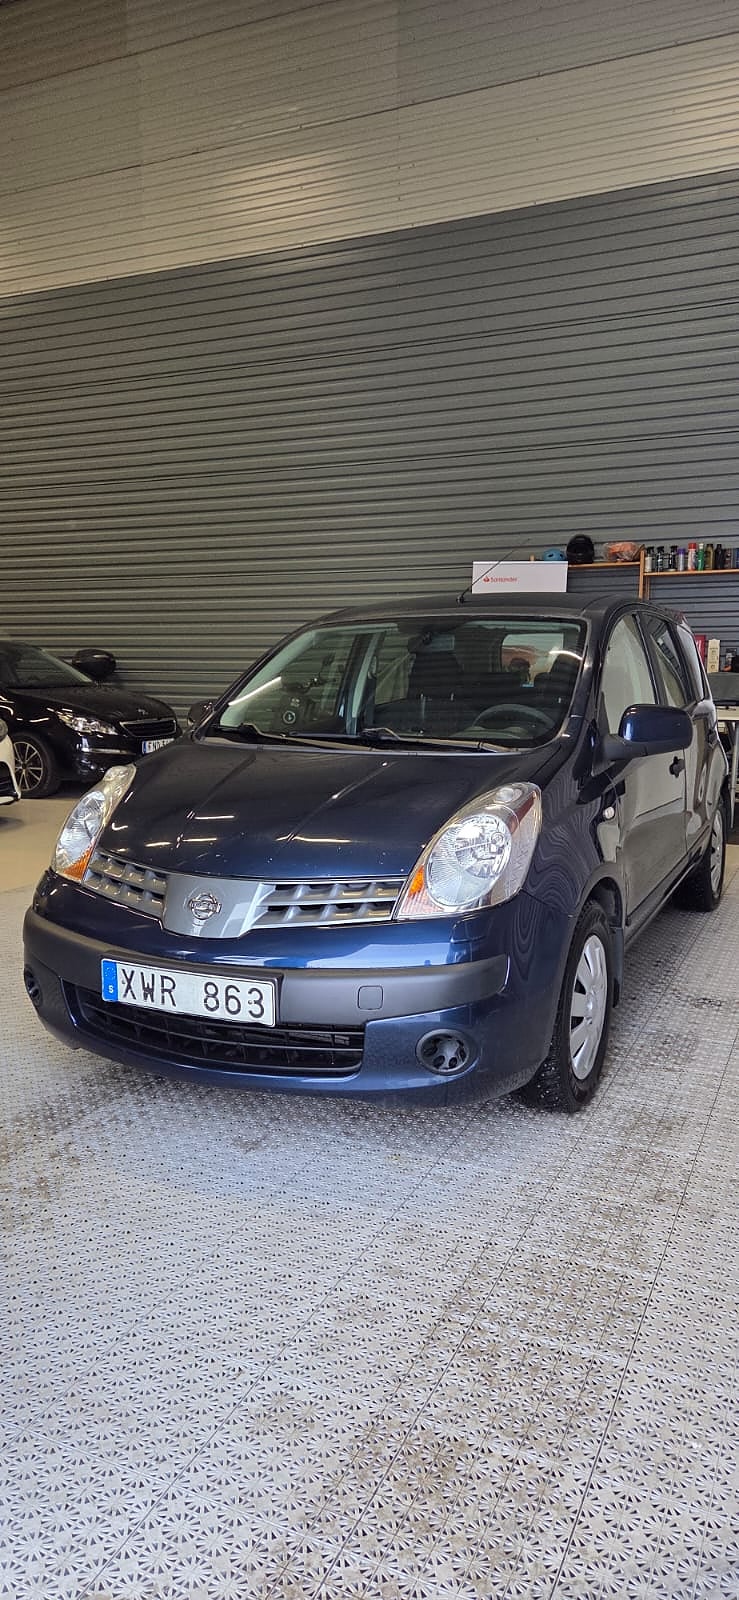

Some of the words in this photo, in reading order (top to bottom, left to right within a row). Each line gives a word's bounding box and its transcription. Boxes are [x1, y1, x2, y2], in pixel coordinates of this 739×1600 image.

[108, 985, 114, 994] S
[121, 968, 177, 1007] XWR
[203, 981, 265, 1019] 863
